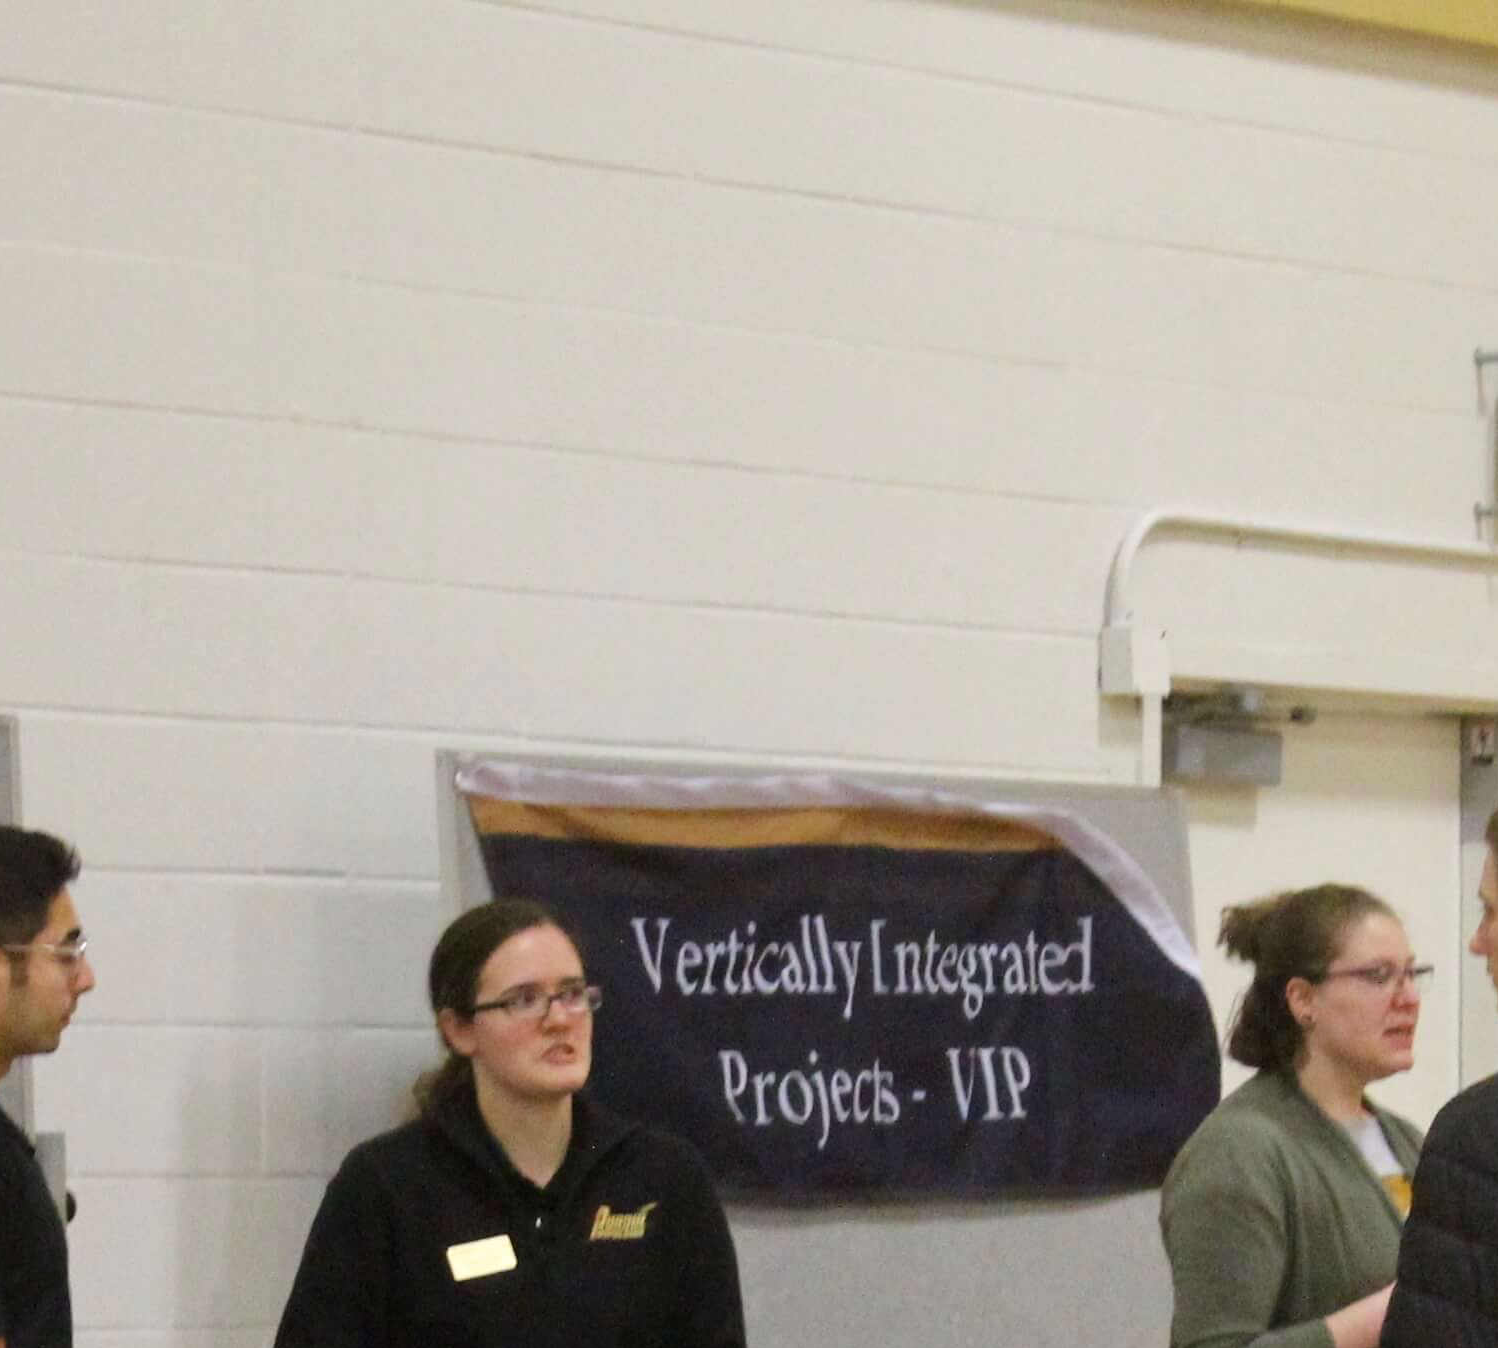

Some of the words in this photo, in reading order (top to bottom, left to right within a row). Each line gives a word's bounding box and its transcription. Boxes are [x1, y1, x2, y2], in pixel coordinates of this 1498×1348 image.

[631, 914, 860, 1018] Vertically
[872, 914, 1095, 1018] Integrated
[718, 1048, 901, 1149] Projects
[946, 1046, 1032, 1121] VIP
